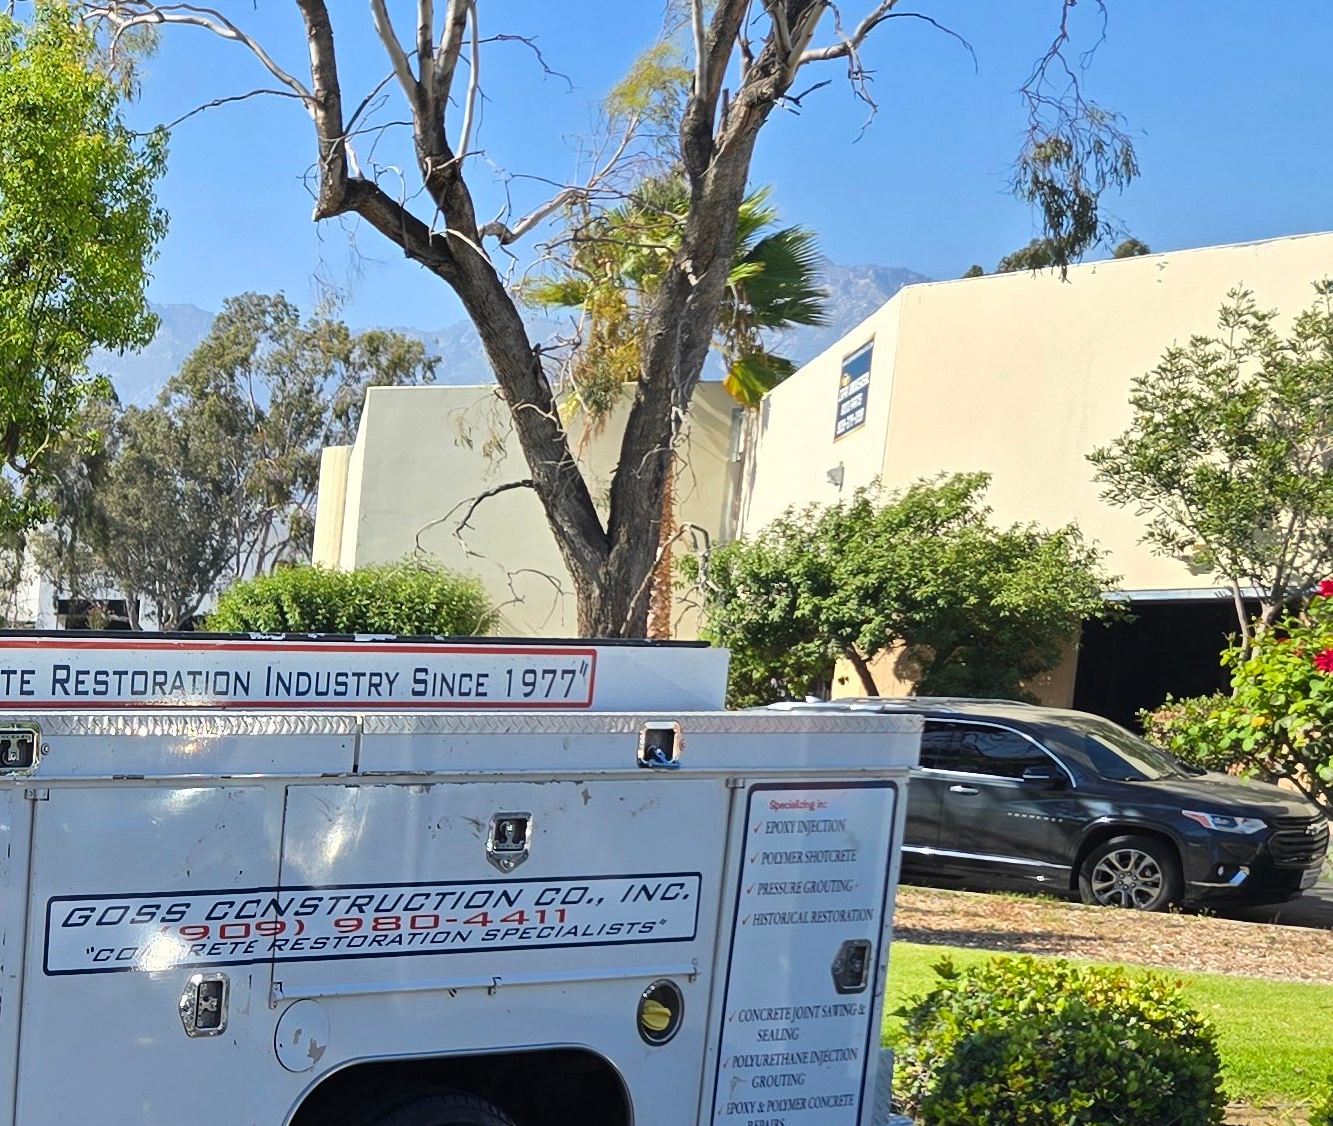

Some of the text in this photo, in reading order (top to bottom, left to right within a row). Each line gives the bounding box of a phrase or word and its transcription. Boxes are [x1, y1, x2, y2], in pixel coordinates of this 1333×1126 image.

[51, 663, 251, 697] RESTORATION
[265, 665, 397, 697] INDUSTRY
[412, 666, 488, 698] SINCE
[504, 660, 589, 699] 1977"
[765, 819, 846, 837] EPOXY INJECTION
[761, 848, 856, 865] POLYMER SHOTCRETE
[757, 880, 803, 895] PRESSURE
[62, 903, 191, 927] GOSS
[205, 889, 524, 921] CONSTRUCTION
[621, 882, 690, 903] INC.
[334, 908, 566, 934] 980-4411
[752, 908, 874, 926] HISTORICAL RESTORATION
[86, 940, 259, 962] "CORETE
[267, 930, 472, 951] RESTORATION
[738, 1007, 791, 1022] CONCRETE
[791, 1005, 821, 1023] JOINT
[757, 1028, 799, 1042] SEALING
[732, 1048, 859, 1068] POLYURETHANE INJECTION
[752, 1073, 805, 1088] GROUTING
[726, 1101, 756, 1115] EPOXY
[766, 1097, 807, 1113] POLYMER
[808, 1094, 855, 1110] CONCRETE
